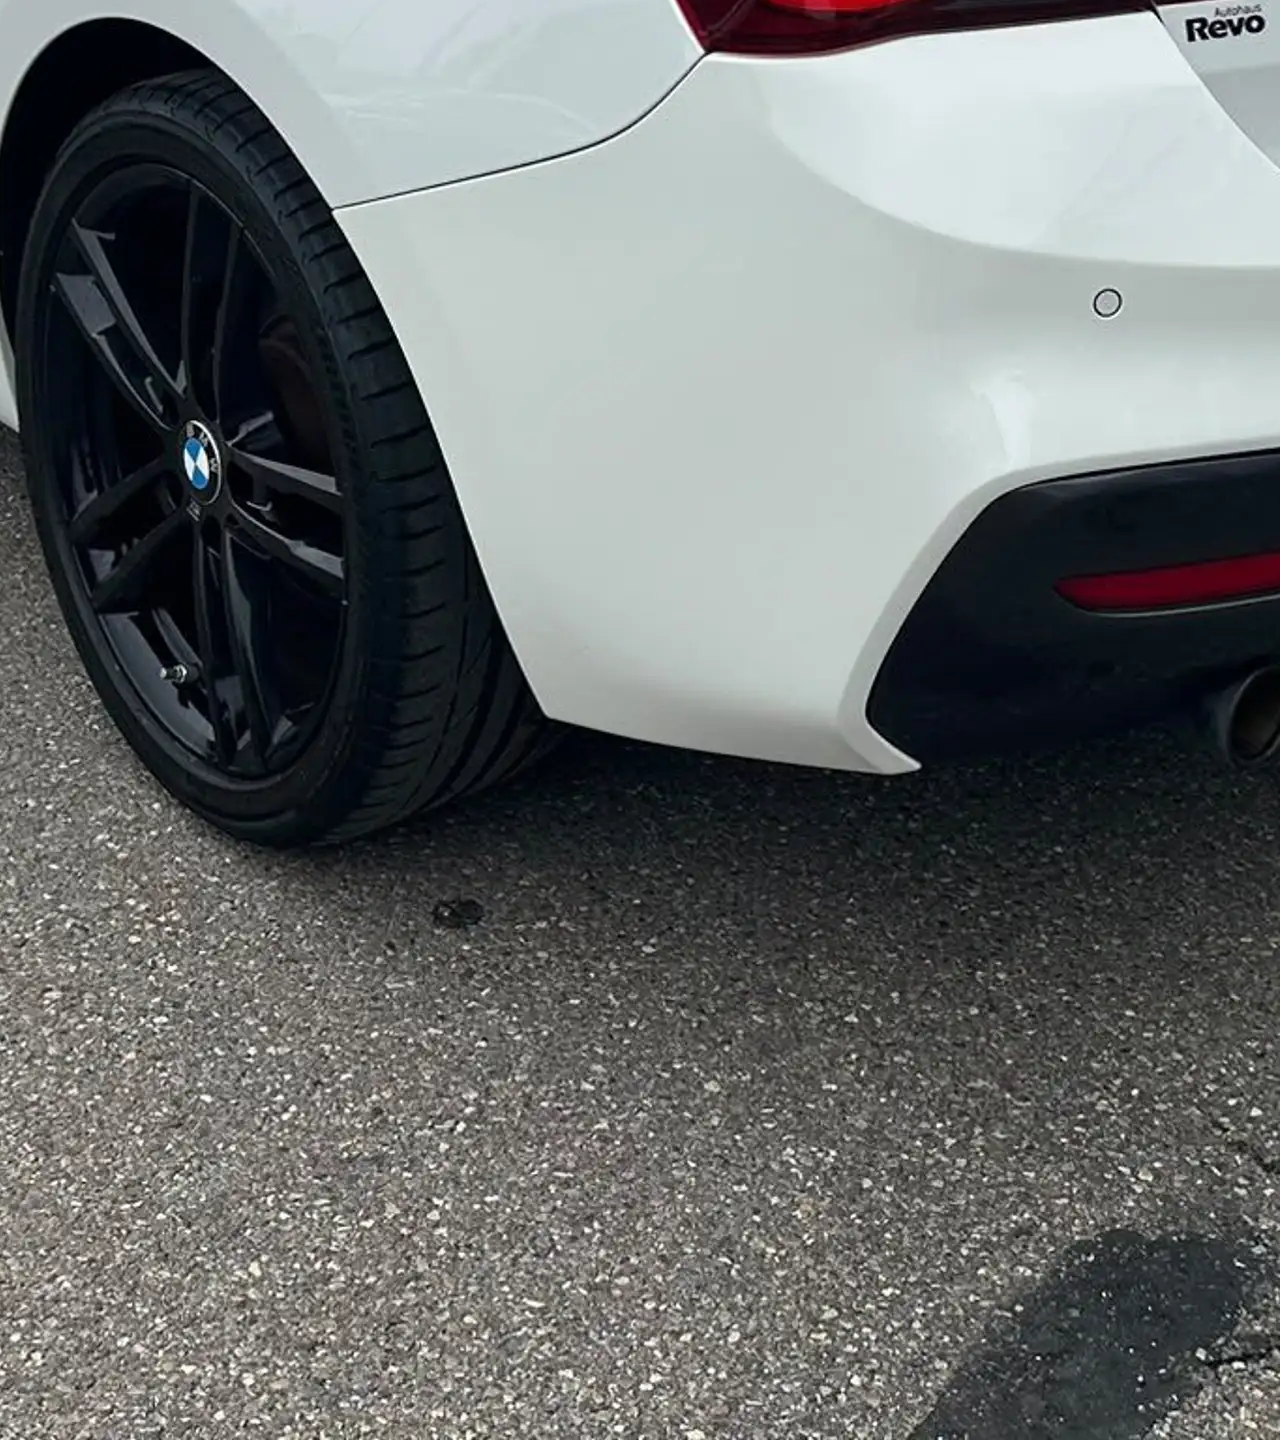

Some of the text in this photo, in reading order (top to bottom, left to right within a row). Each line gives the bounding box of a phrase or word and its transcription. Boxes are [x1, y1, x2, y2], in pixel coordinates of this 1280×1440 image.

[1213, 4, 1262, 18] Autohaus
[1185, 14, 1266, 43] Revo
[186, 422, 220, 474] BMW
